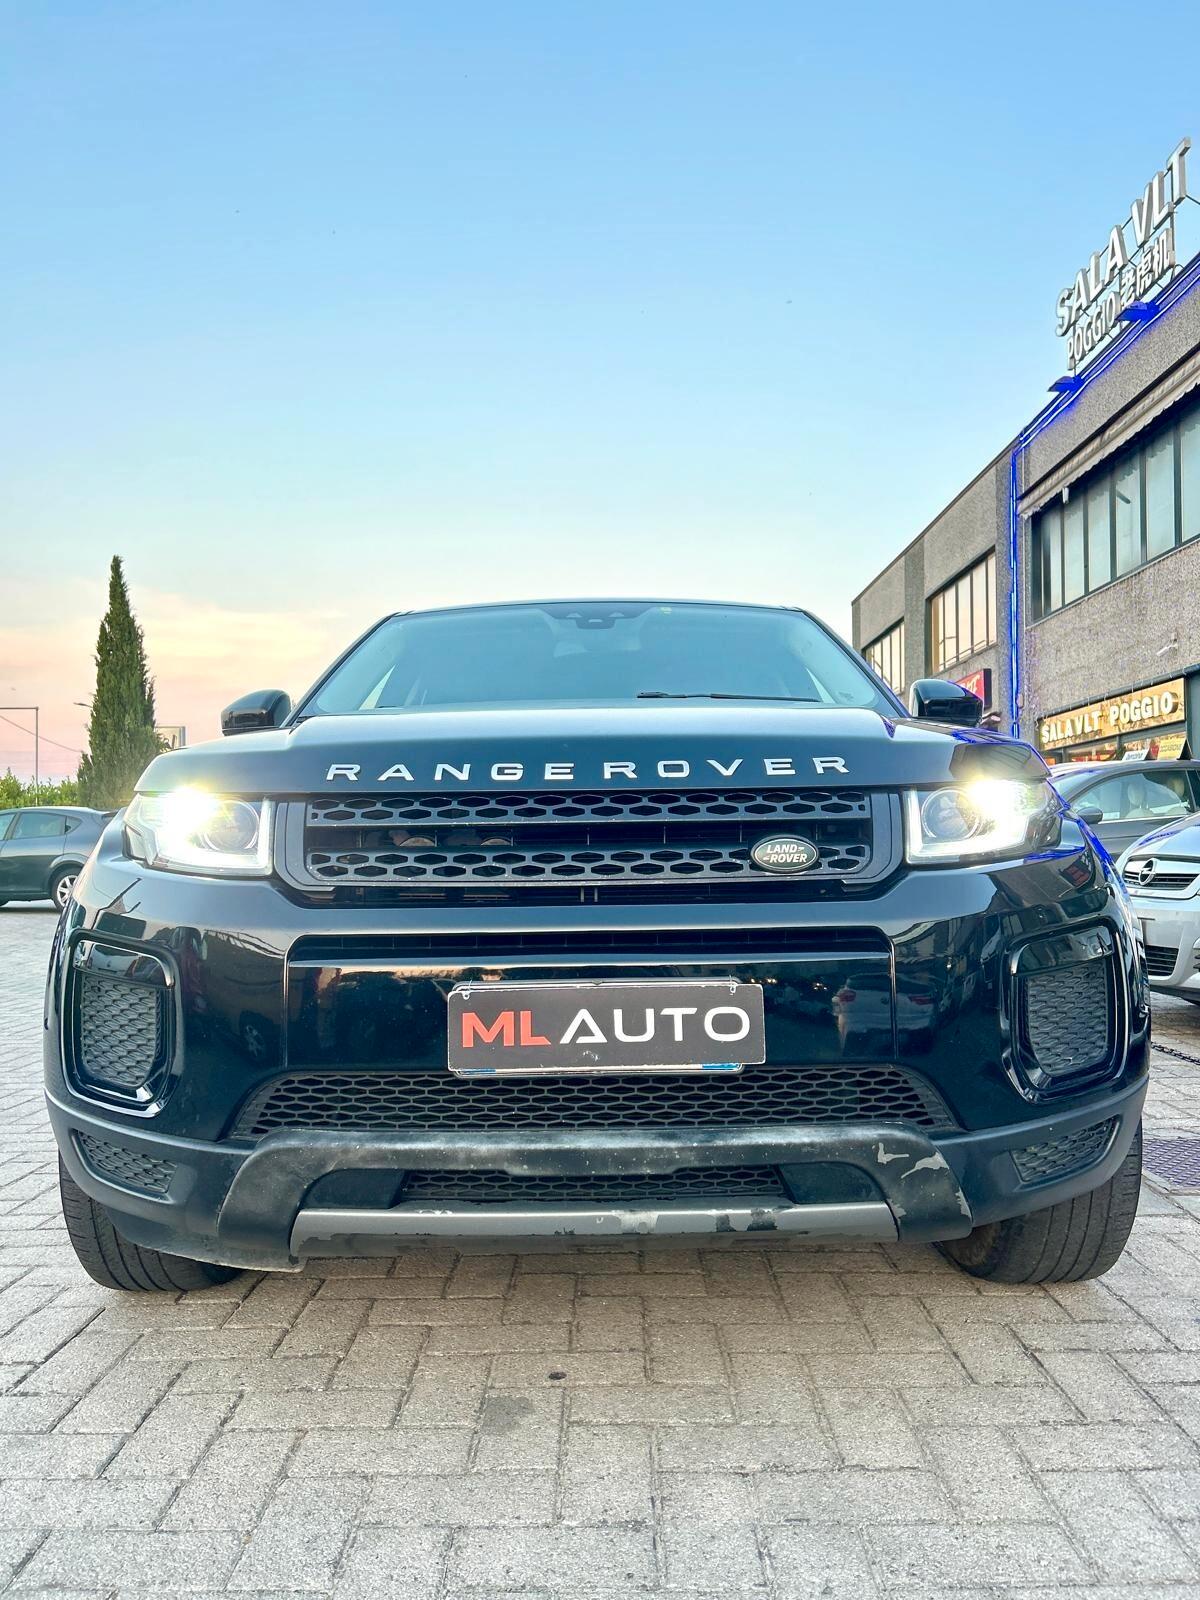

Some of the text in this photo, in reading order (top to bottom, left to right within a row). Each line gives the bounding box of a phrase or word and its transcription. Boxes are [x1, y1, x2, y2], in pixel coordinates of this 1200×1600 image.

[1056, 136, 1191, 337] SALA VLT
[1067, 291, 1120, 370] POGGIO
[1109, 691, 1178, 726] POGGIO
[326, 757, 850, 781] RANGE ROVER
[462, 1006, 751, 1048] ML AUTO
